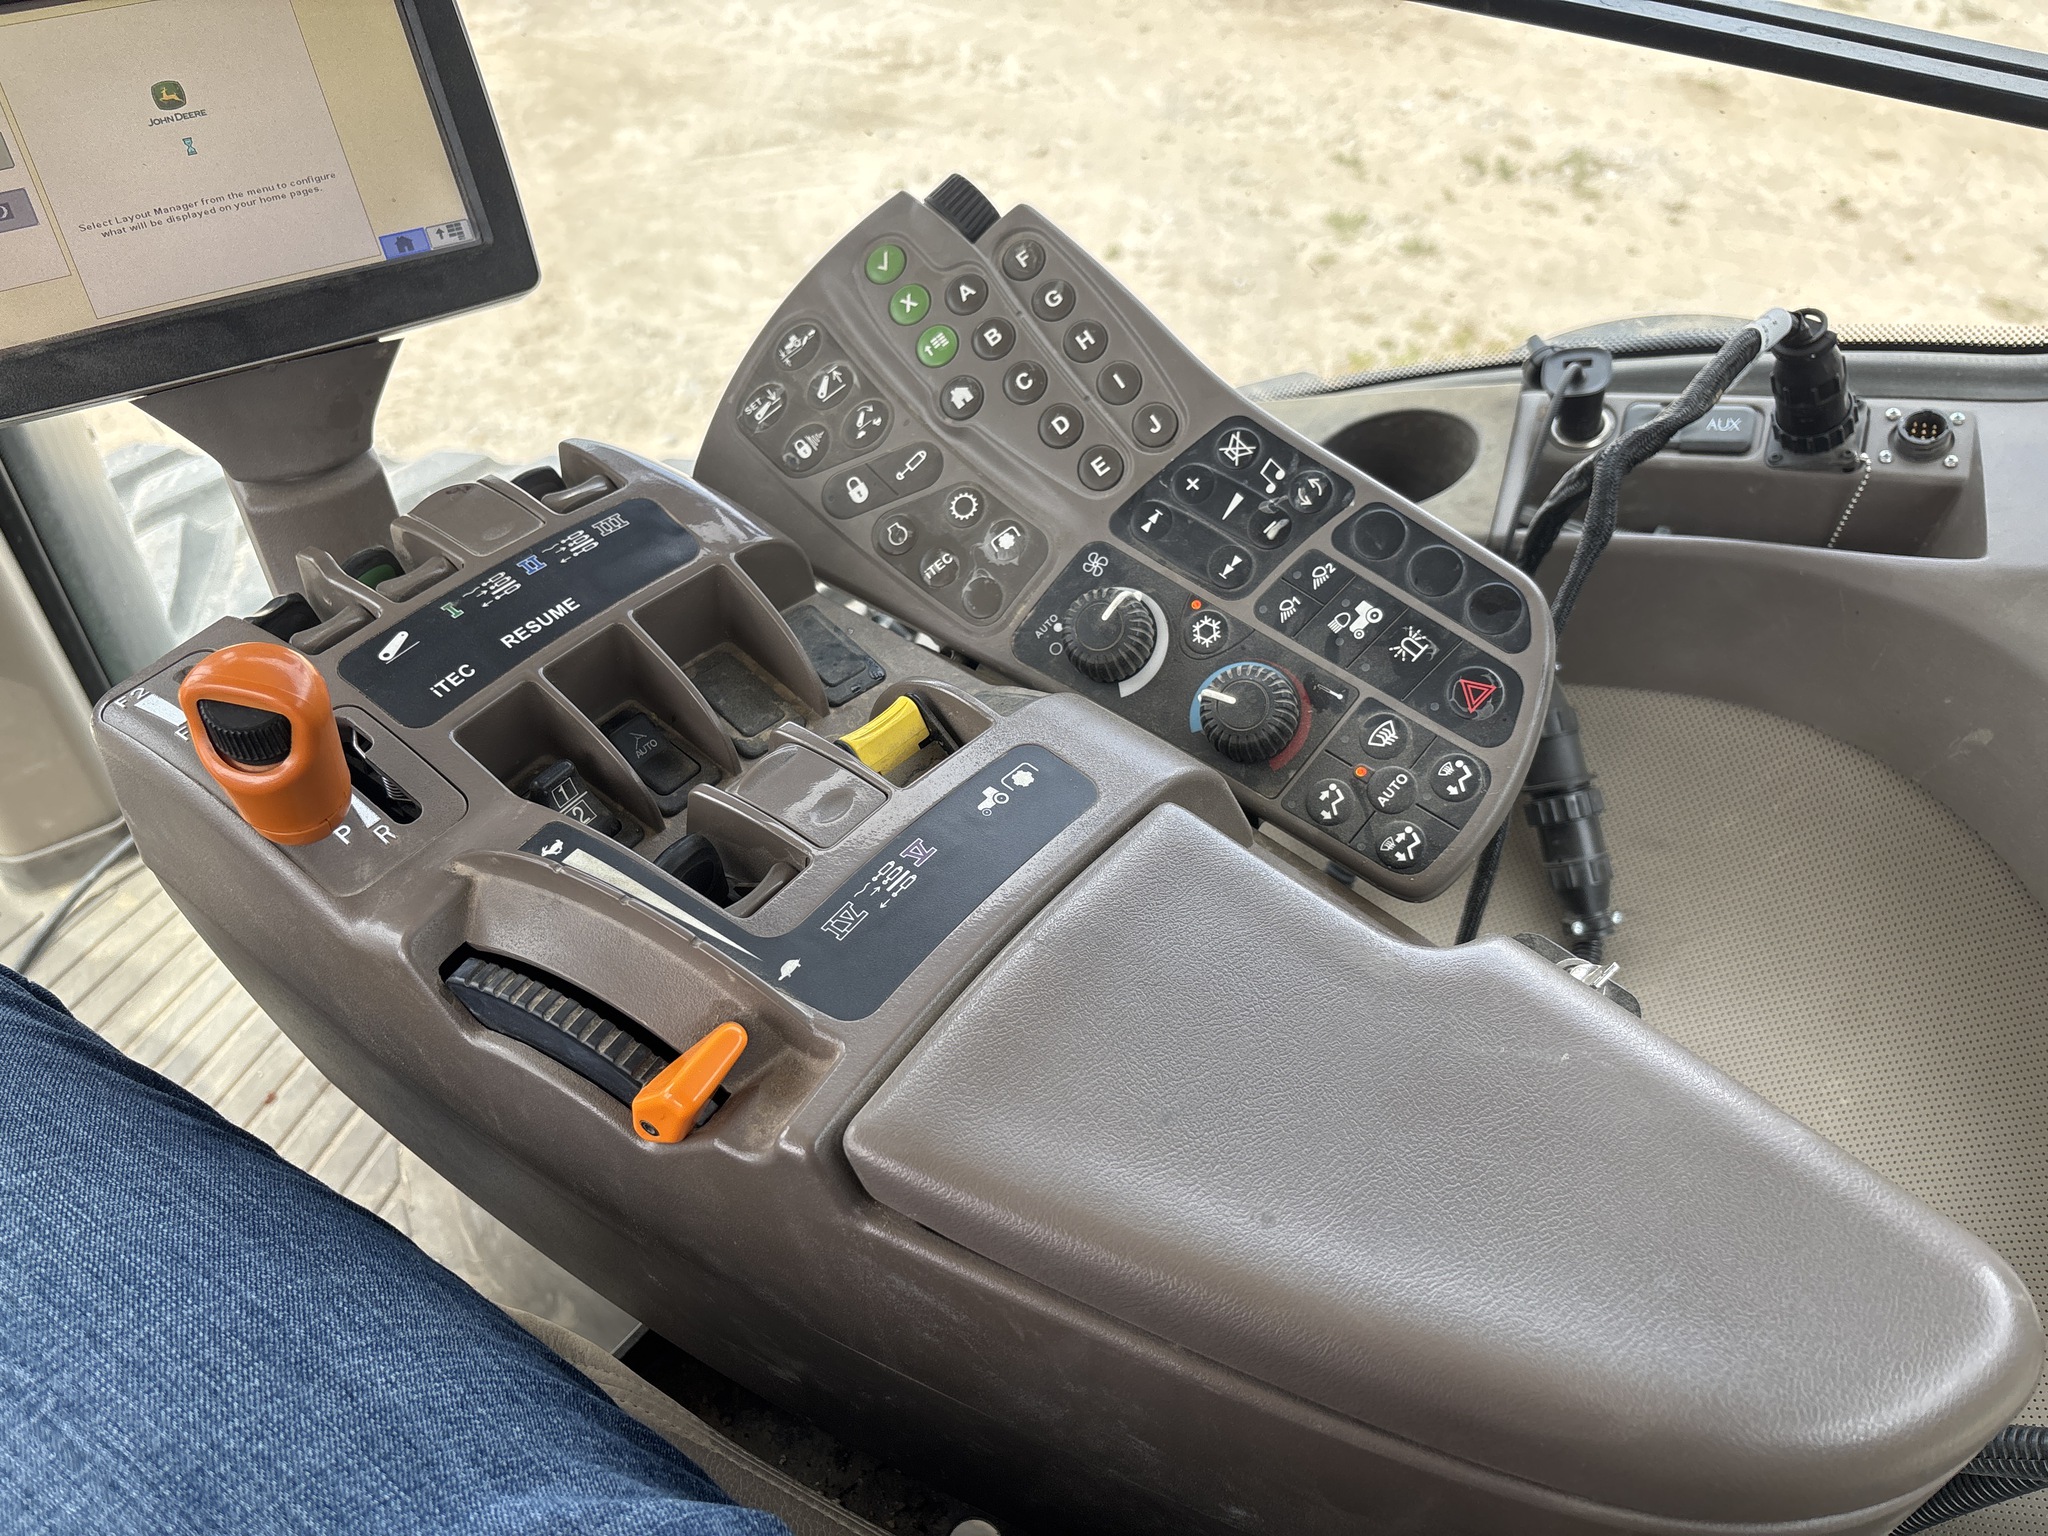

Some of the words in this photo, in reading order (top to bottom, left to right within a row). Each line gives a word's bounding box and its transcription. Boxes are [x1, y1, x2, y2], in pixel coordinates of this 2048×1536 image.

[148, 115, 175, 127] JOHN
[174, 109, 207, 122] DEERE
[78, 218, 113, 232] Select
[115, 210, 151, 224] Layout
[153, 200, 198, 216] Manager
[200, 195, 225, 206] from
[227, 191, 244, 200] the
[247, 184, 275, 196] menu
[276, 182, 287, 190] to
[290, 172, 336, 187] configure
[100, 226, 127, 238] what
[129, 221, 148, 232] will
[150, 219, 163, 227] be
[166, 207, 216, 223] displayed
[219, 204, 232, 212] on
[233, 198, 257, 211] your
[259, 193, 287, 204] home
[289, 185, 323, 199] pages.
[1015, 249, 1030, 268] F
[958, 284, 976, 302] A
[1044, 289, 1063, 308] G
[983, 327, 1003, 347] B
[1075, 329, 1096, 351] H
[1015, 372, 1033, 390] C
[1112, 373, 1126, 390] I
[744, 396, 763, 415] SET
[1050, 415, 1070, 435] D
[1149, 414, 1162, 434] J
[1705, 417, 1742, 432] AUX
[1090, 455, 1111, 477] E
[923, 552, 954, 580] iTEC
[1325, 562, 1337, 574] 2
[1292, 596, 1301, 605] 1
[500, 597, 581, 649] RESUME
[1034, 614, 1058, 639] AUTO
[429, 663, 476, 698] iTEC
[635, 739, 658, 759] AUTO
[558, 784, 570, 801] 1
[1377, 773, 1408, 808] AUTO
[571, 806, 591, 824] 2
[333, 824, 351, 846] P
[372, 824, 397, 846] R
